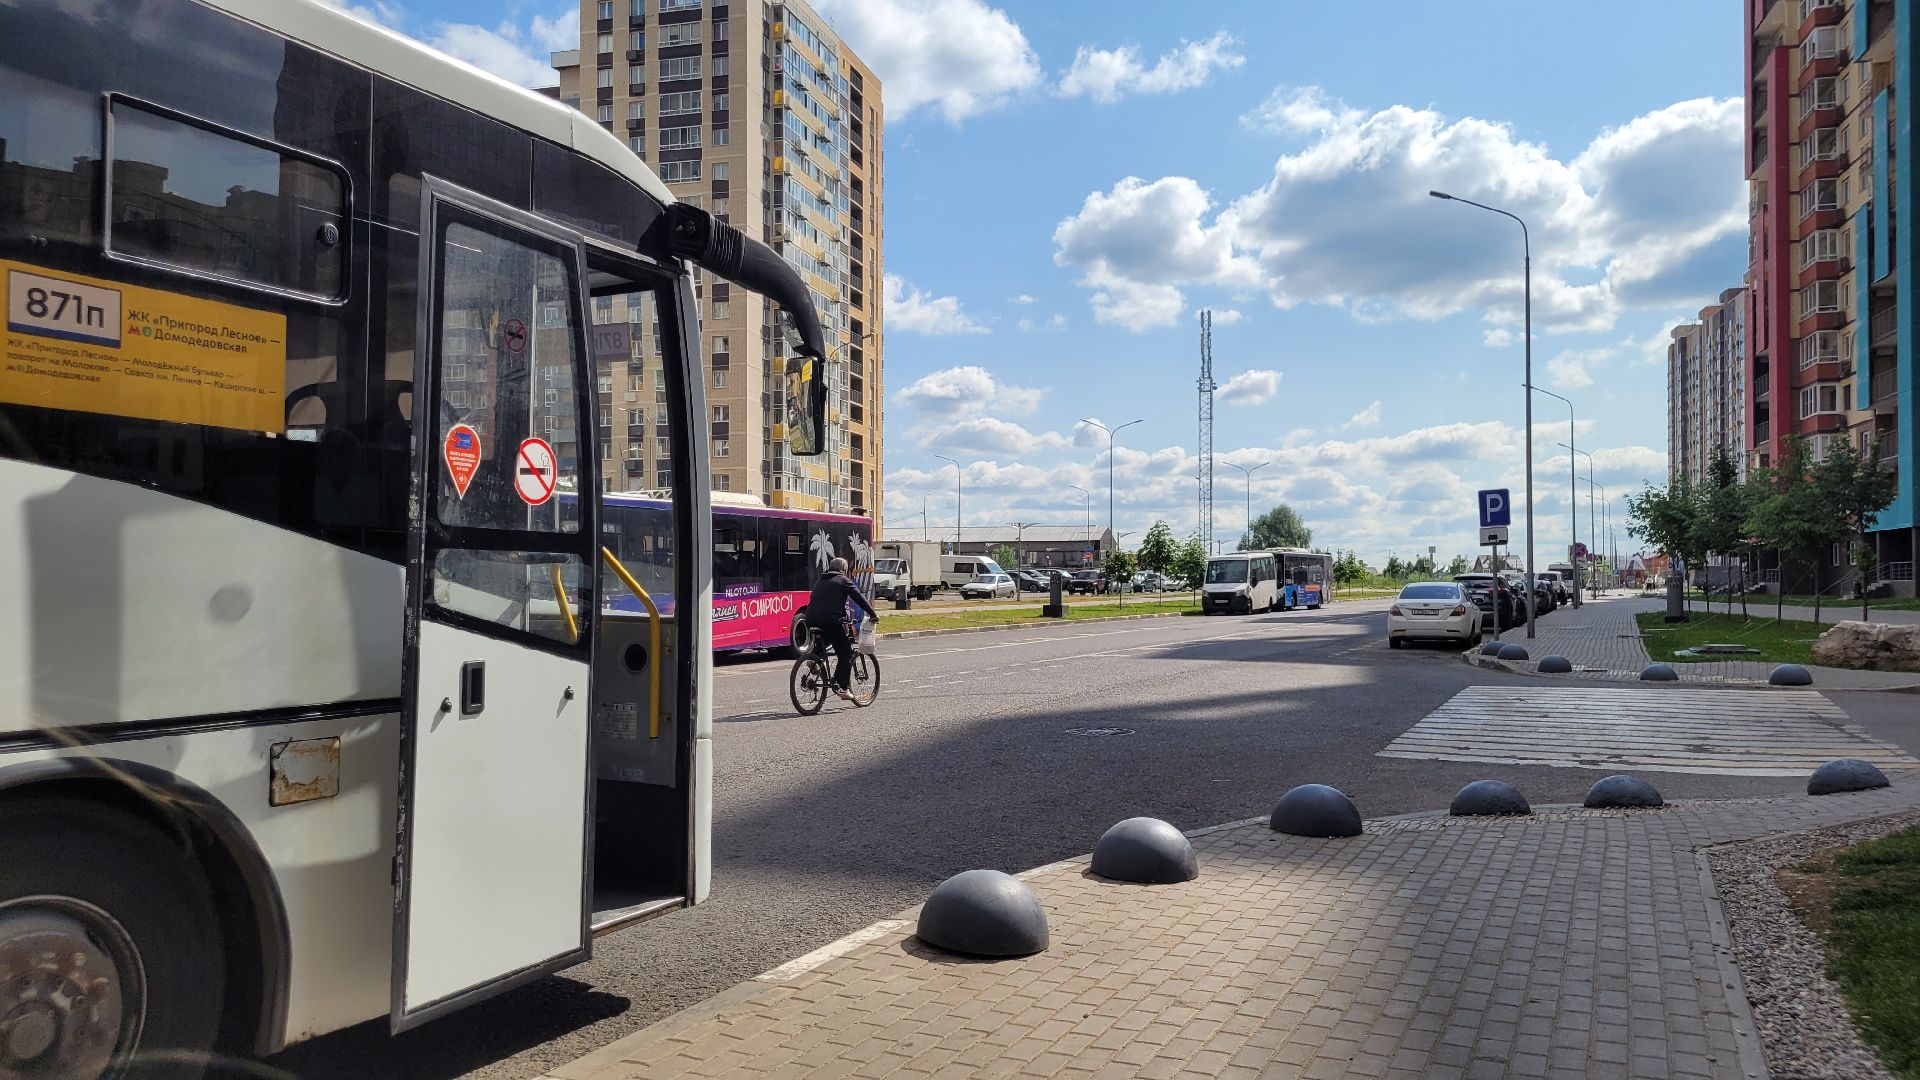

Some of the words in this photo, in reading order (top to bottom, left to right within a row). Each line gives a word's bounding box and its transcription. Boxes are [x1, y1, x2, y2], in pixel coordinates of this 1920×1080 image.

[26, 287, 105, 329] 871п
[127, 309, 150, 323] ЖК
[153, 315, 218, 338] «Пригород
[220, 328, 267, 344] Лесное»
[154, 328, 248, 354] Домодедовская
[7, 338, 24, 349] ЖК
[26, 342, 79, 358] «Пригород
[132, 357, 191, 373] Молодёжный
[7, 352, 46, 363] поворот
[62, 359, 111, 373] Молоково
[124, 367, 154, 379] Совхоз
[172, 375, 202, 386] Ленина
[214, 380, 257, 394] Каширское
[25, 365, 101, 382] Домодедовская
[1485, 493, 1504, 523] P
[741, 601, 748, 620] В
